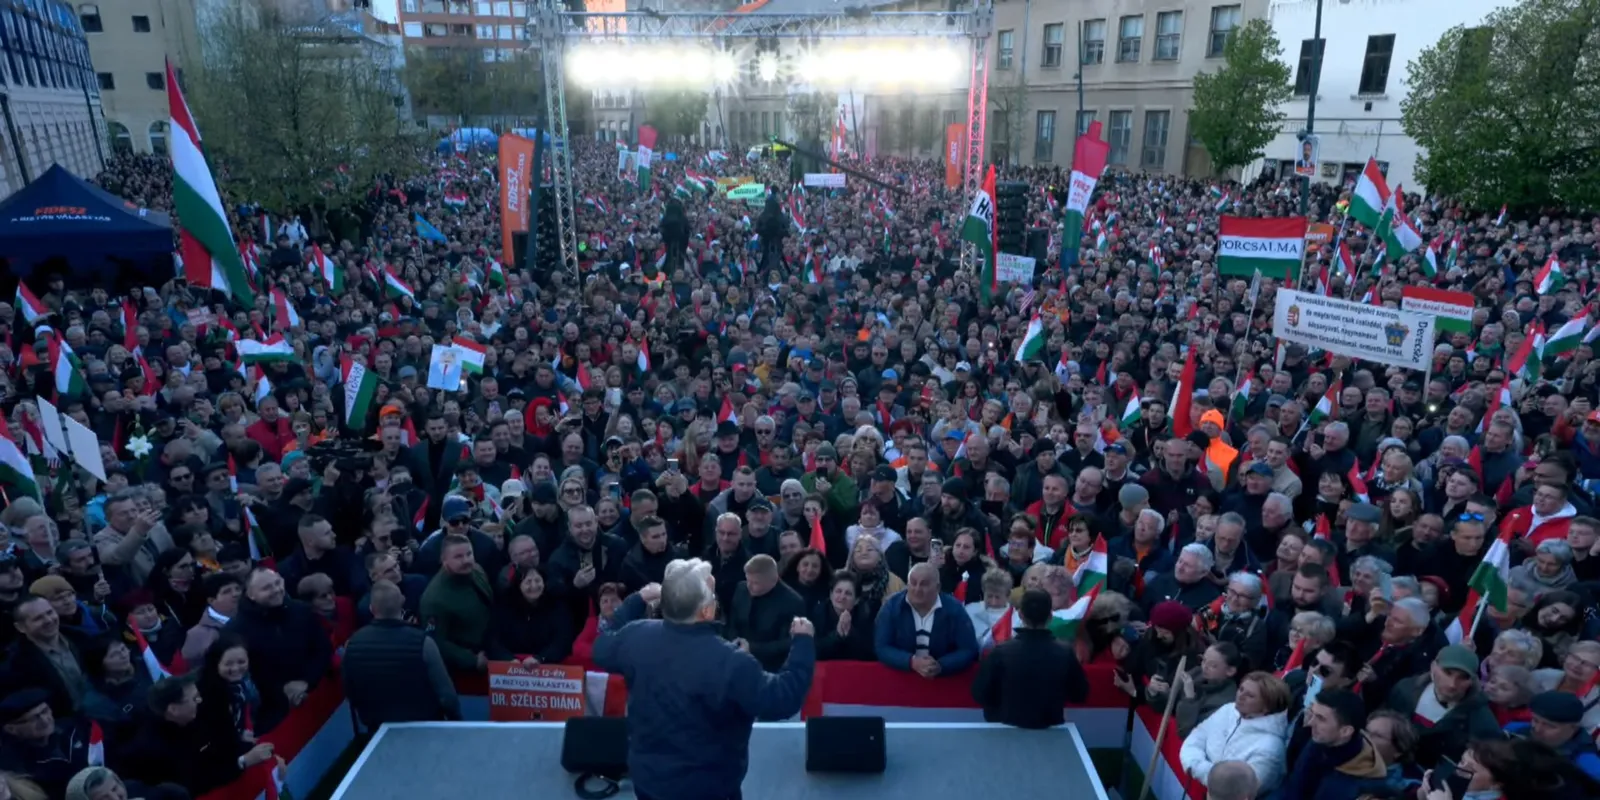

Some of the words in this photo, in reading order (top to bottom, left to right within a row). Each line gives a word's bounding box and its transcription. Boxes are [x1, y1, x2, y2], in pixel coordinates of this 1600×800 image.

[507, 167, 519, 212] FIDESZ
[35, 206, 87, 215] FIDESZ
[1219, 239, 1298, 254] PORCSALMA
[1412, 320, 1429, 364] Derecske
[507, 666, 540, 677] ÁPRIS
[542, 668, 566, 679] 12-ÉN
[502, 679, 530, 687] BIZTOS
[491, 692, 509, 706] DR.
[511, 692, 548, 709] SZÉLES
[549, 693, 582, 710] DIÁNA
